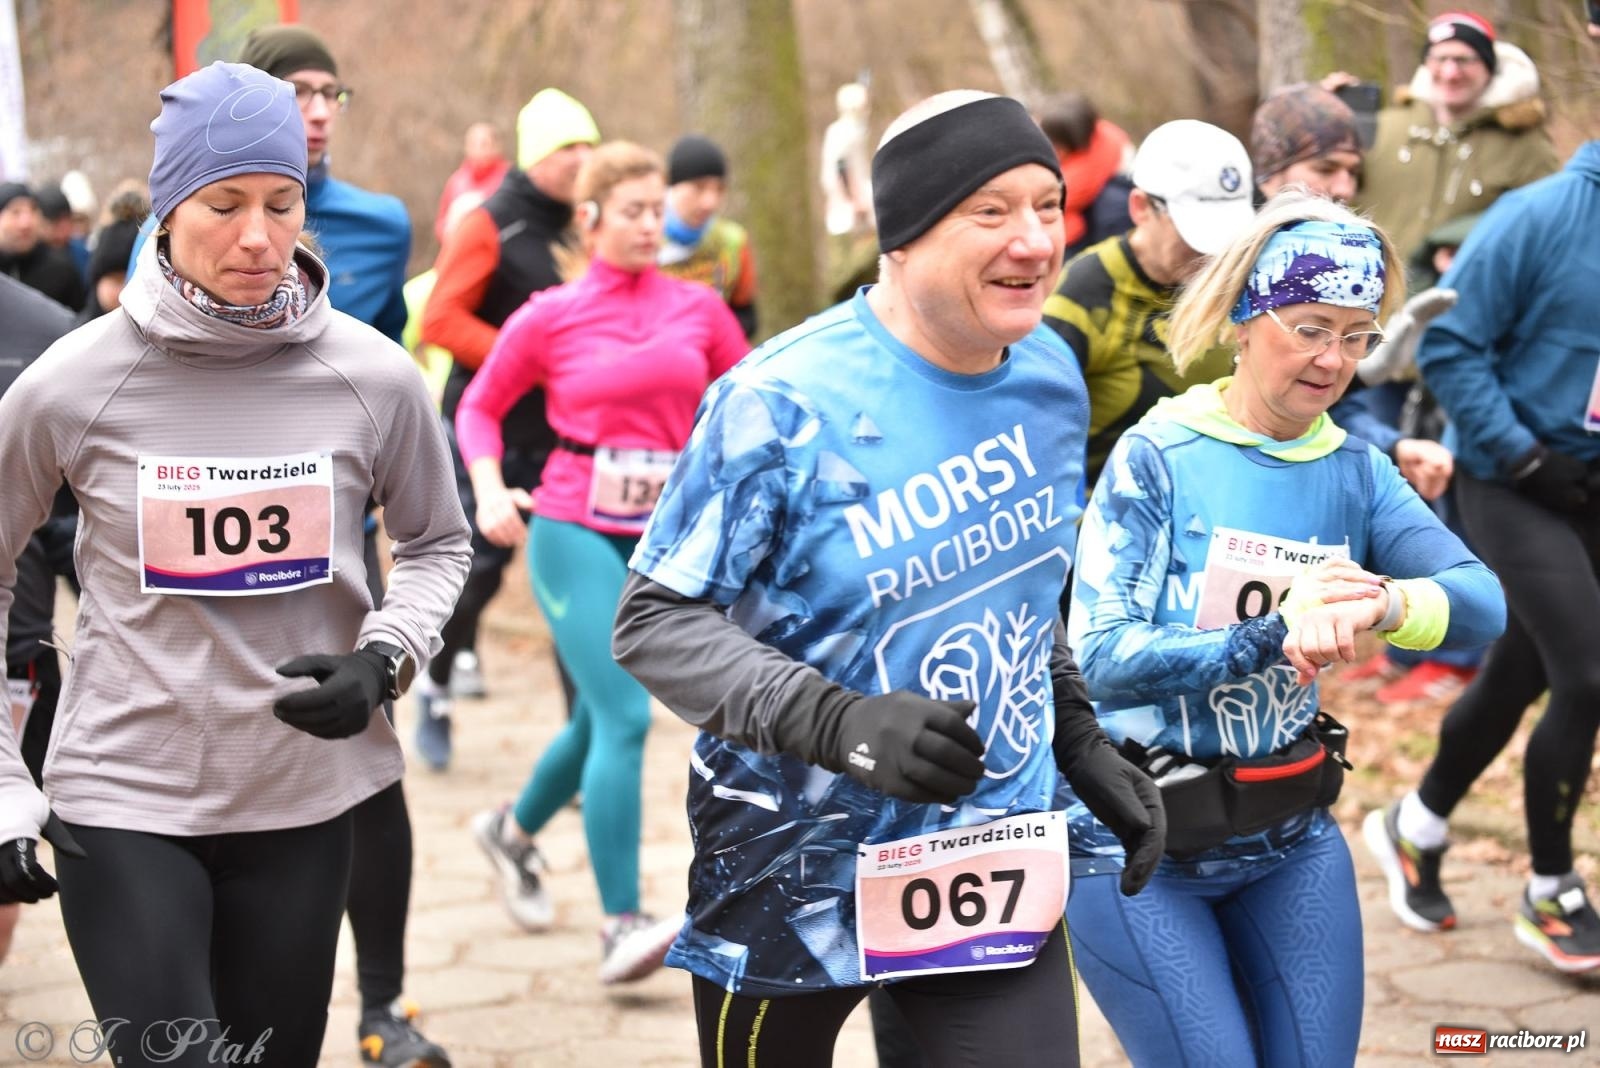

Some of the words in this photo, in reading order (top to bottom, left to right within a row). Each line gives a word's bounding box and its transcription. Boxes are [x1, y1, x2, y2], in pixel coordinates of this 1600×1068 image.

[157, 465, 200, 480] BIEG
[206, 462, 317, 481] Twardziela
[157, 483, 165, 491] 23
[167, 484, 181, 492] luty
[842, 424, 1038, 559] MORSY
[185, 504, 291, 556] 103
[865, 485, 1063, 609] RACIBÓRZ
[1227, 536, 1268, 556] BIEG
[259, 570, 302, 582] Racibórz
[877, 844, 923, 863] BIEG
[928, 823, 1046, 853] Twardziela
[901, 869, 1025, 930] 067
[986, 943, 1034, 956] Racibórz
